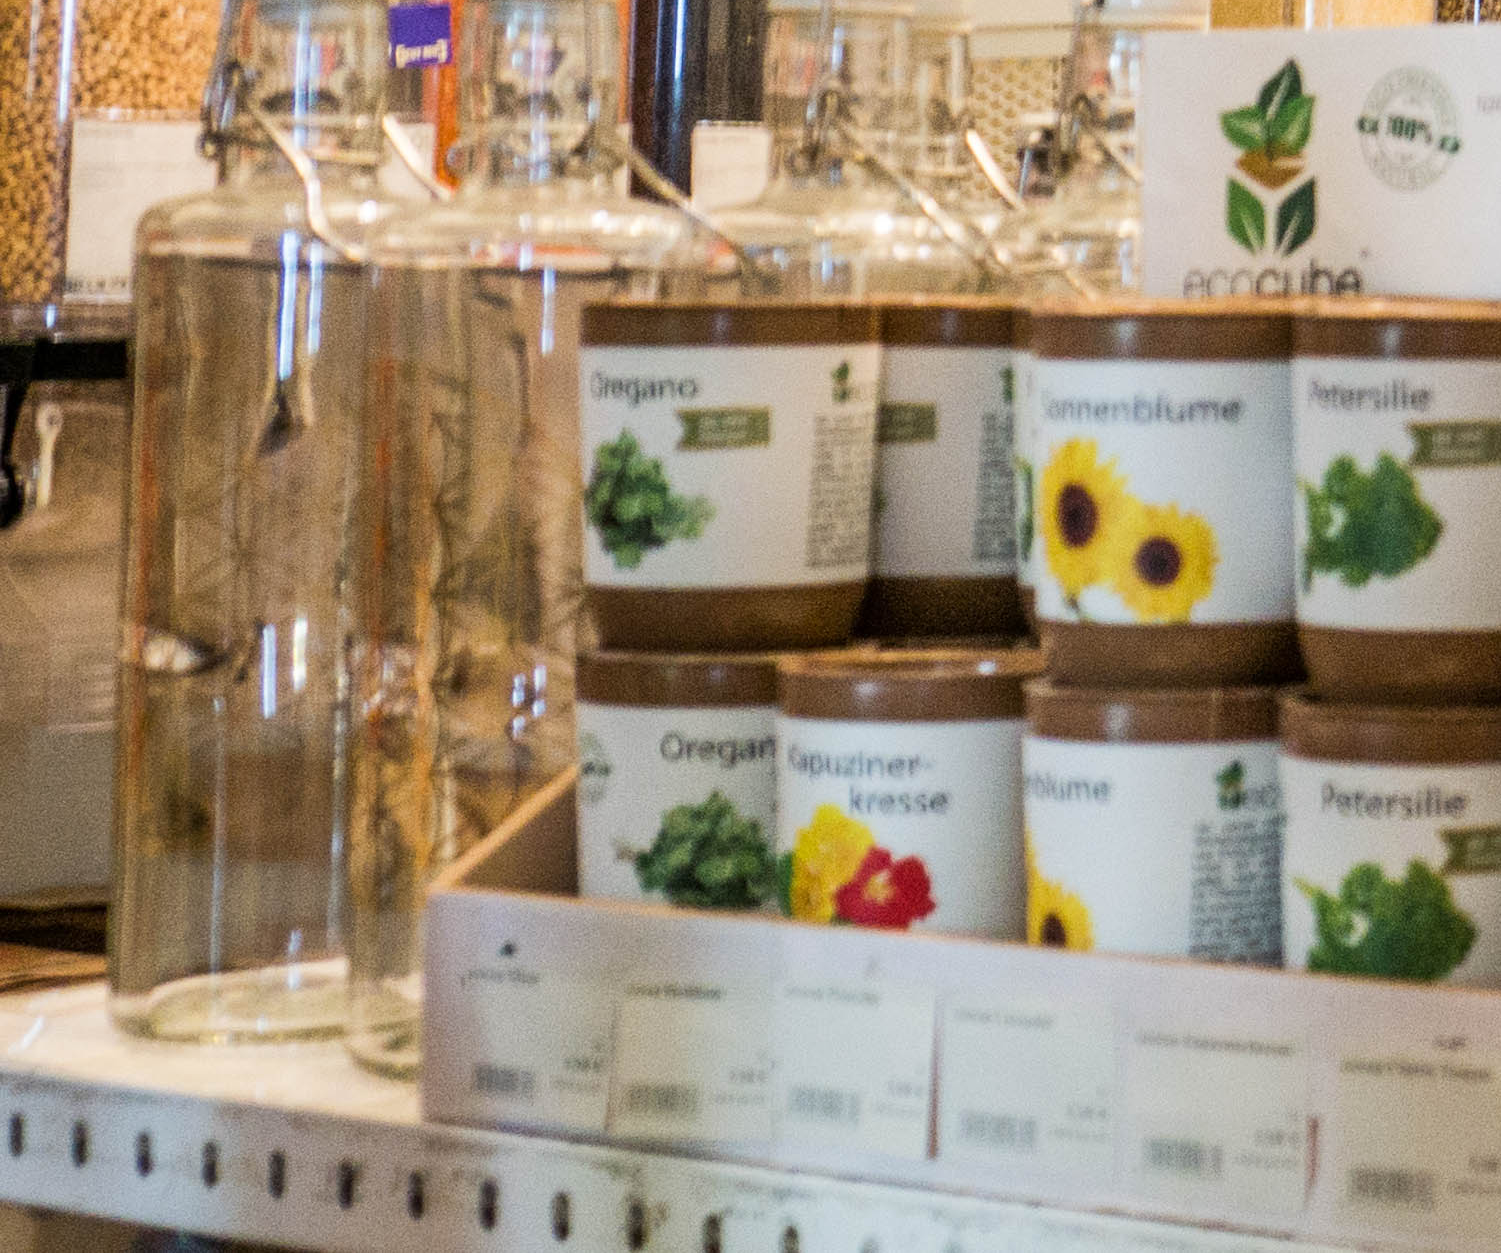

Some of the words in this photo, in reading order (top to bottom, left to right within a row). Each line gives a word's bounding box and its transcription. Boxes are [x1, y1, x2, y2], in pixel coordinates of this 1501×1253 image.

[1183, 257, 1363, 297] ecocube
[590, 370, 698, 408] Oregano
[661, 730, 776, 768] Oregan
[848, 785, 950, 816] kresse
[1321, 779, 1469, 820] Petersilie
